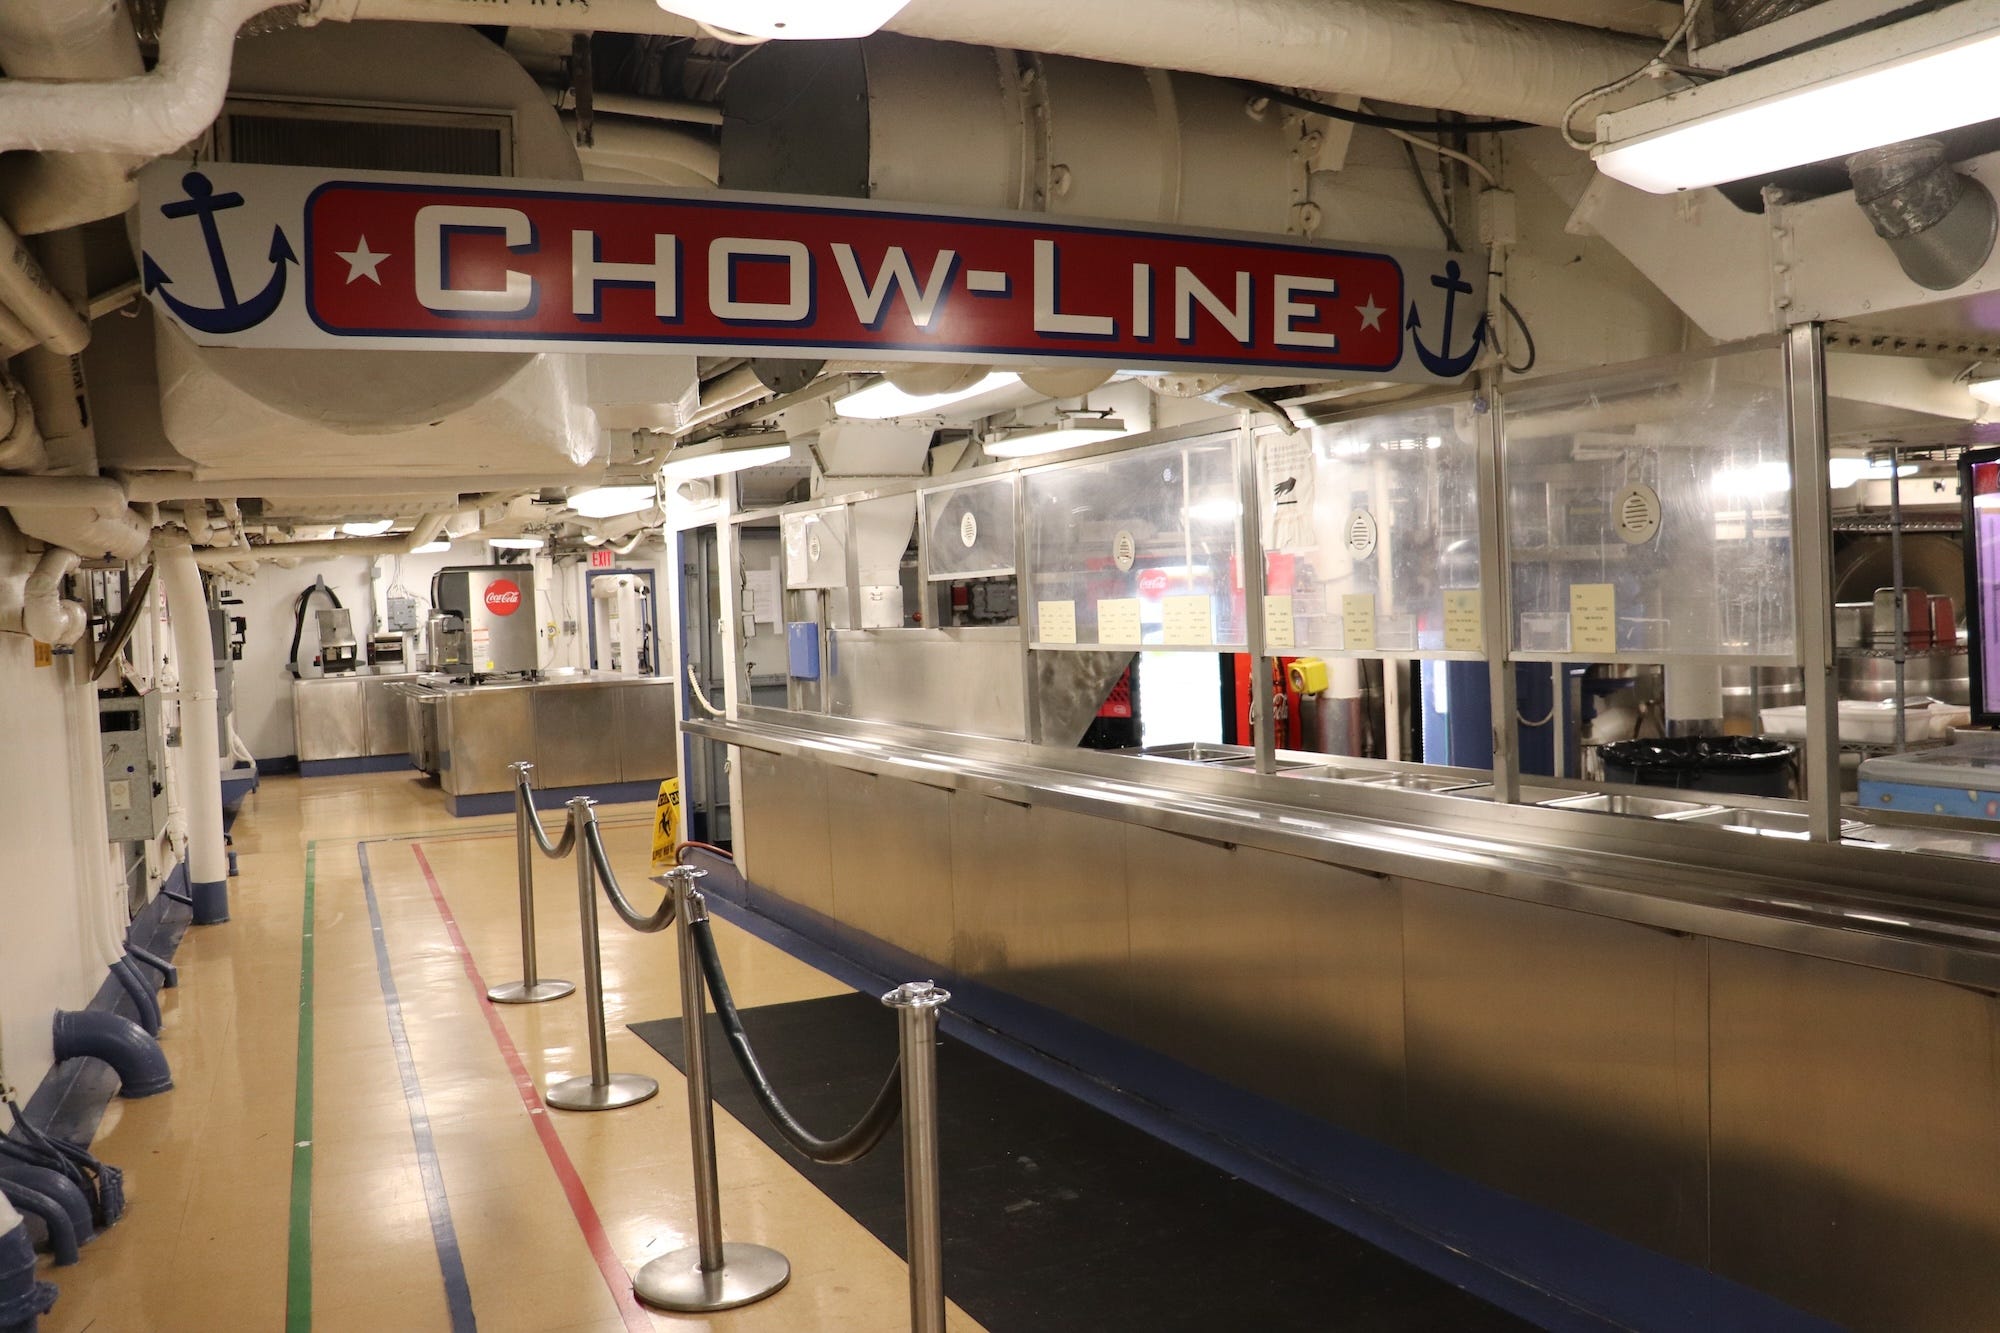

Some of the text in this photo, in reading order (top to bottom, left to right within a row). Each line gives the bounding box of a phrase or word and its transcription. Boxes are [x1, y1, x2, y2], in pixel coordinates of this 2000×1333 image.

[414, 205, 1336, 350] CHOW-LINE
[592, 551, 611, 567] EXIT
[486, 591, 519, 604] Coca-Cola
